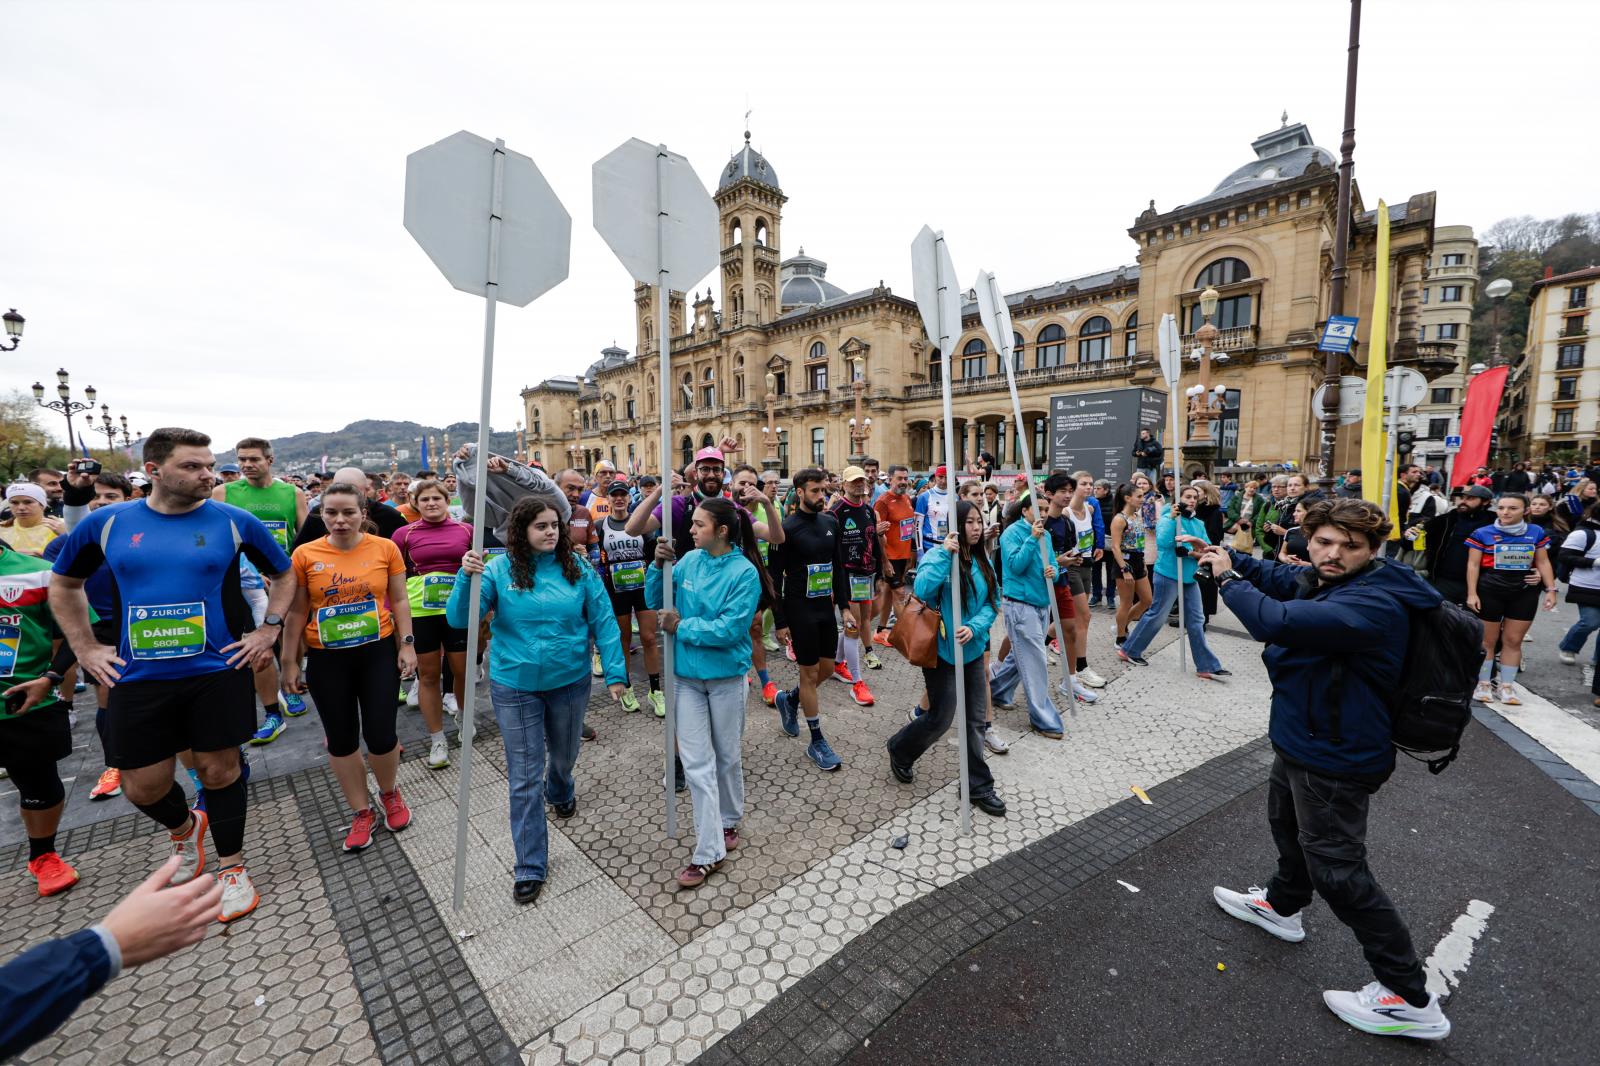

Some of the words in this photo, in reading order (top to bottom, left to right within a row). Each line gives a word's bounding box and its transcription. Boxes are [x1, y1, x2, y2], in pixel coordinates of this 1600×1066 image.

[596, 505, 609, 513] ULC
[151, 607, 191, 617] ZURICH
[339, 604, 367, 614] ZURICH
[336, 620, 368, 631] DORA
[142, 626, 195, 638] DÁNIEL
[153, 639, 179, 648] 5809
